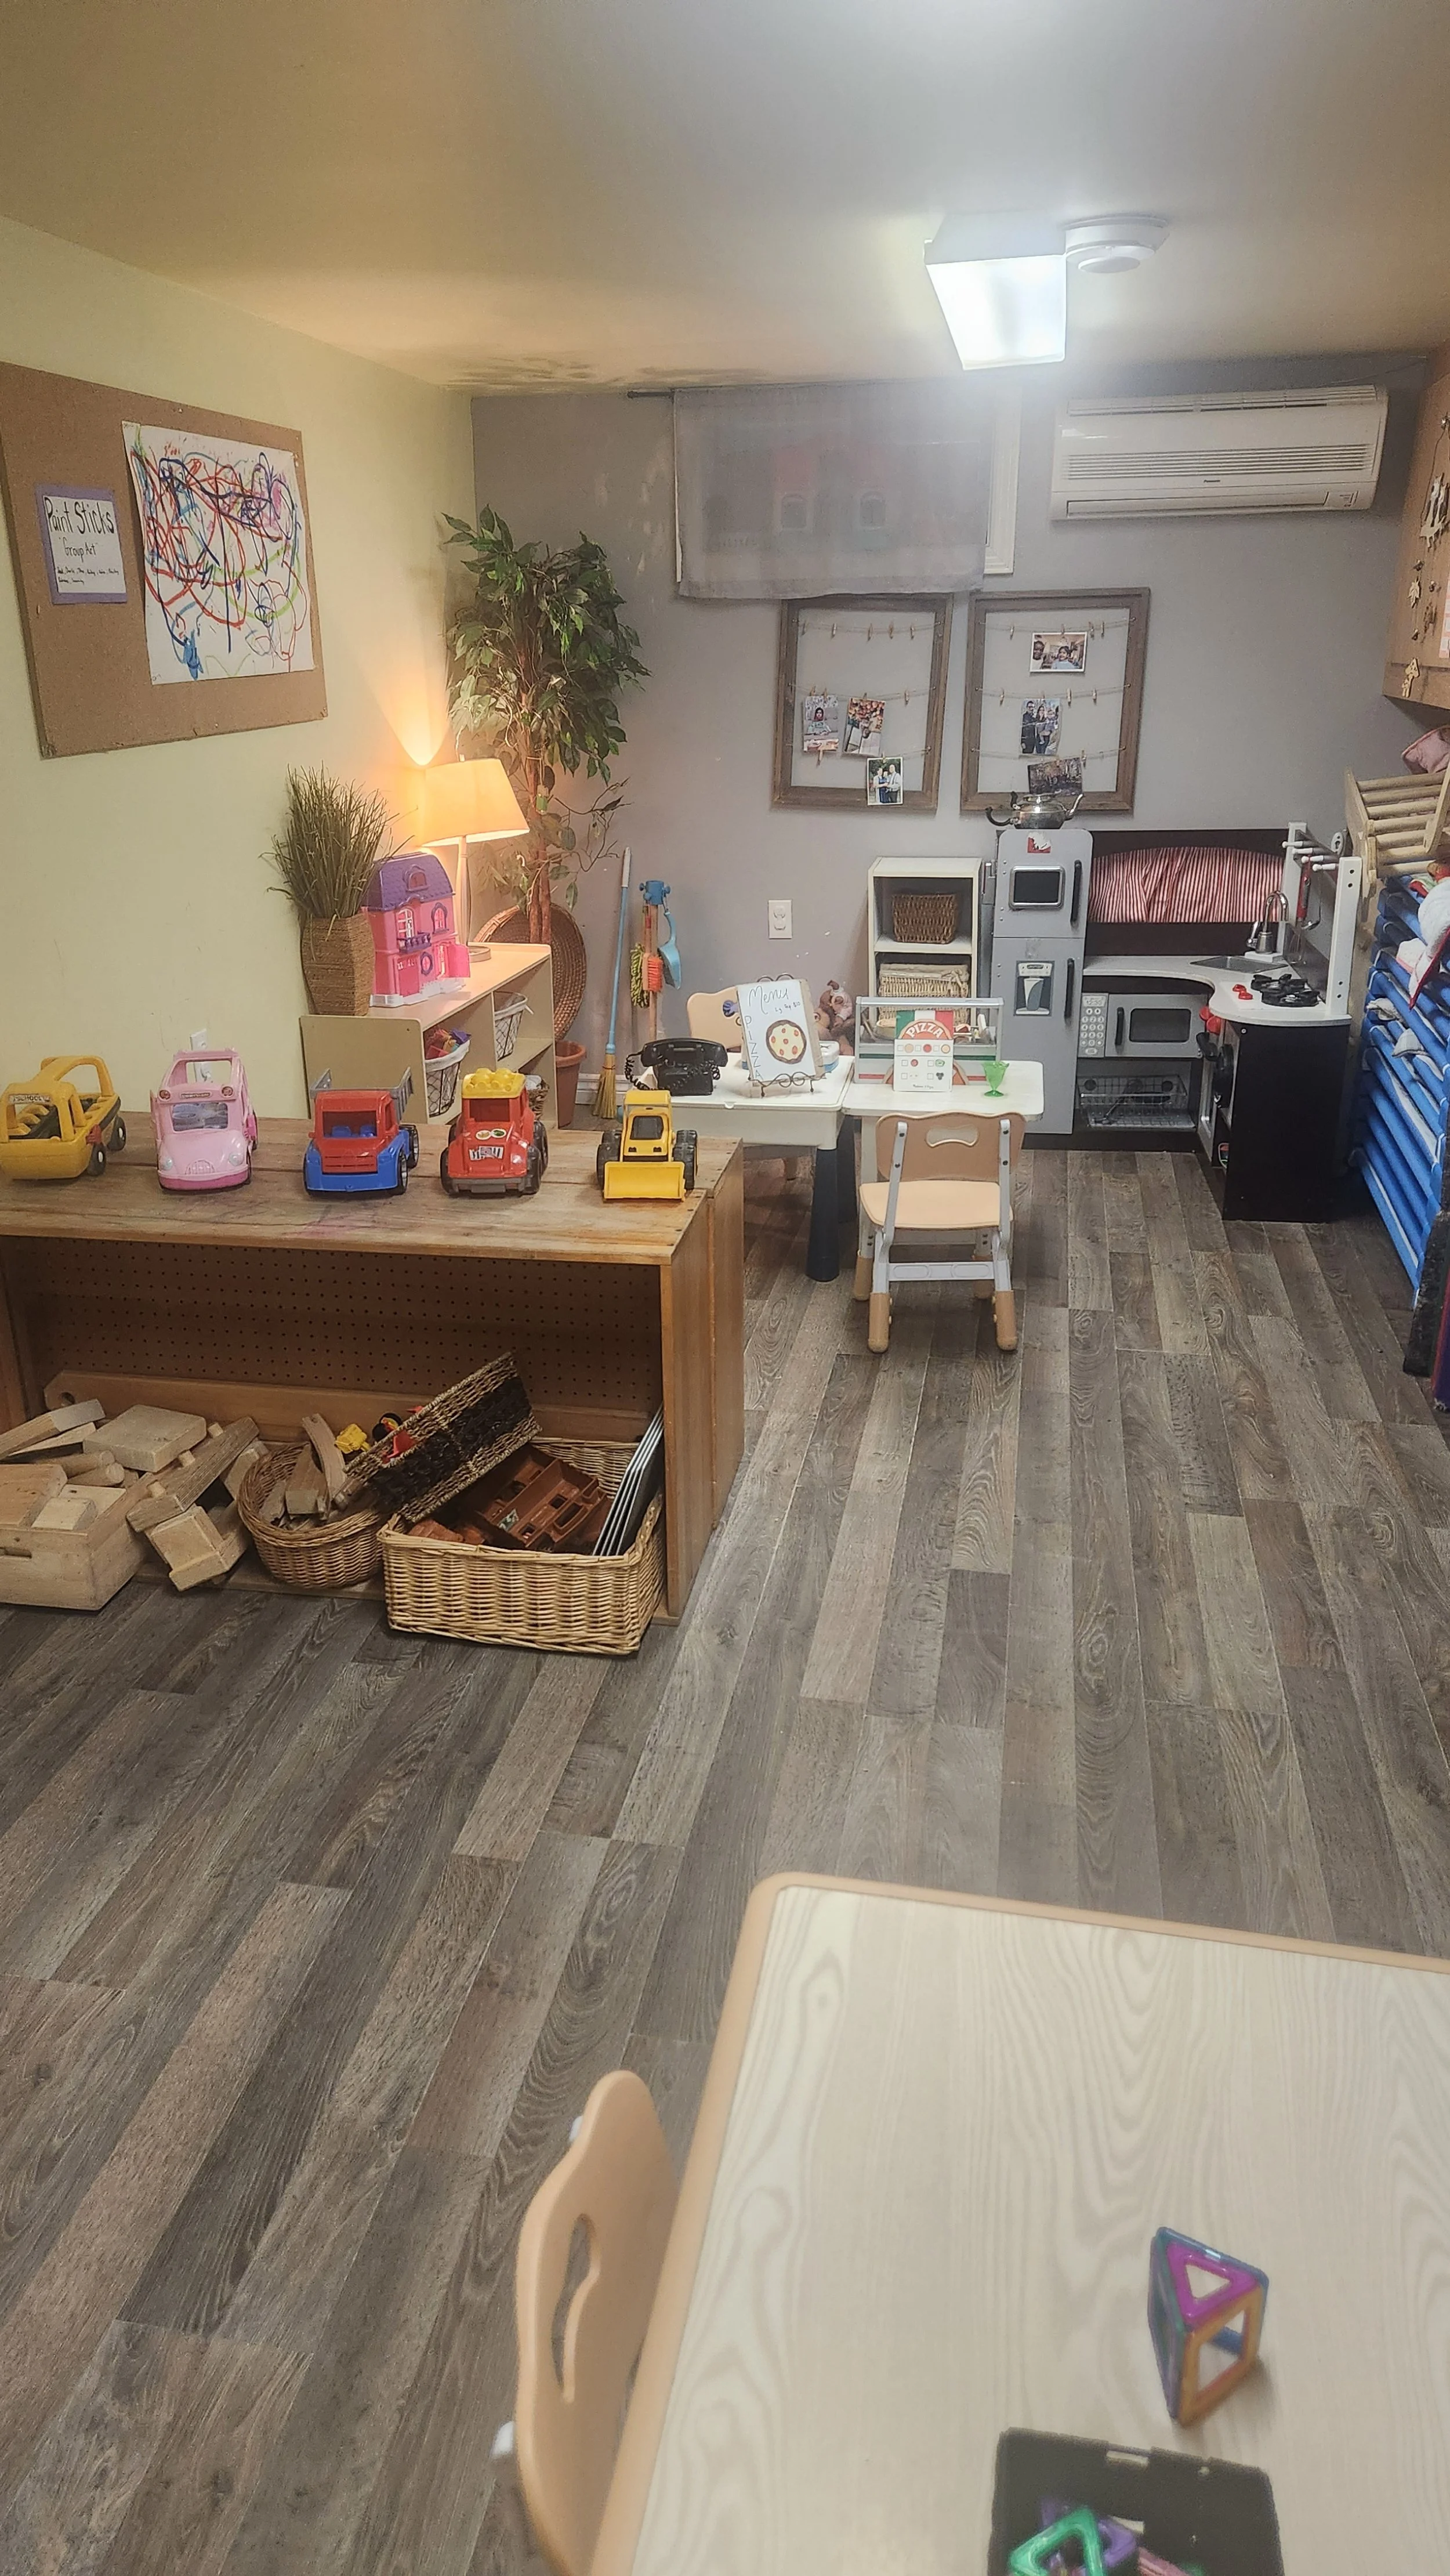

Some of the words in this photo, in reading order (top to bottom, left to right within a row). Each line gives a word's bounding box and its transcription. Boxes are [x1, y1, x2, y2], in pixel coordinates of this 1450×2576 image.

[44, 497, 73, 533] Paint
[74, 501, 114, 534] Sticks
[749, 986, 789, 1015] Menu
[905, 1022, 944, 1038] PIZZA
[744, 1016, 764, 1081] PIZZA
